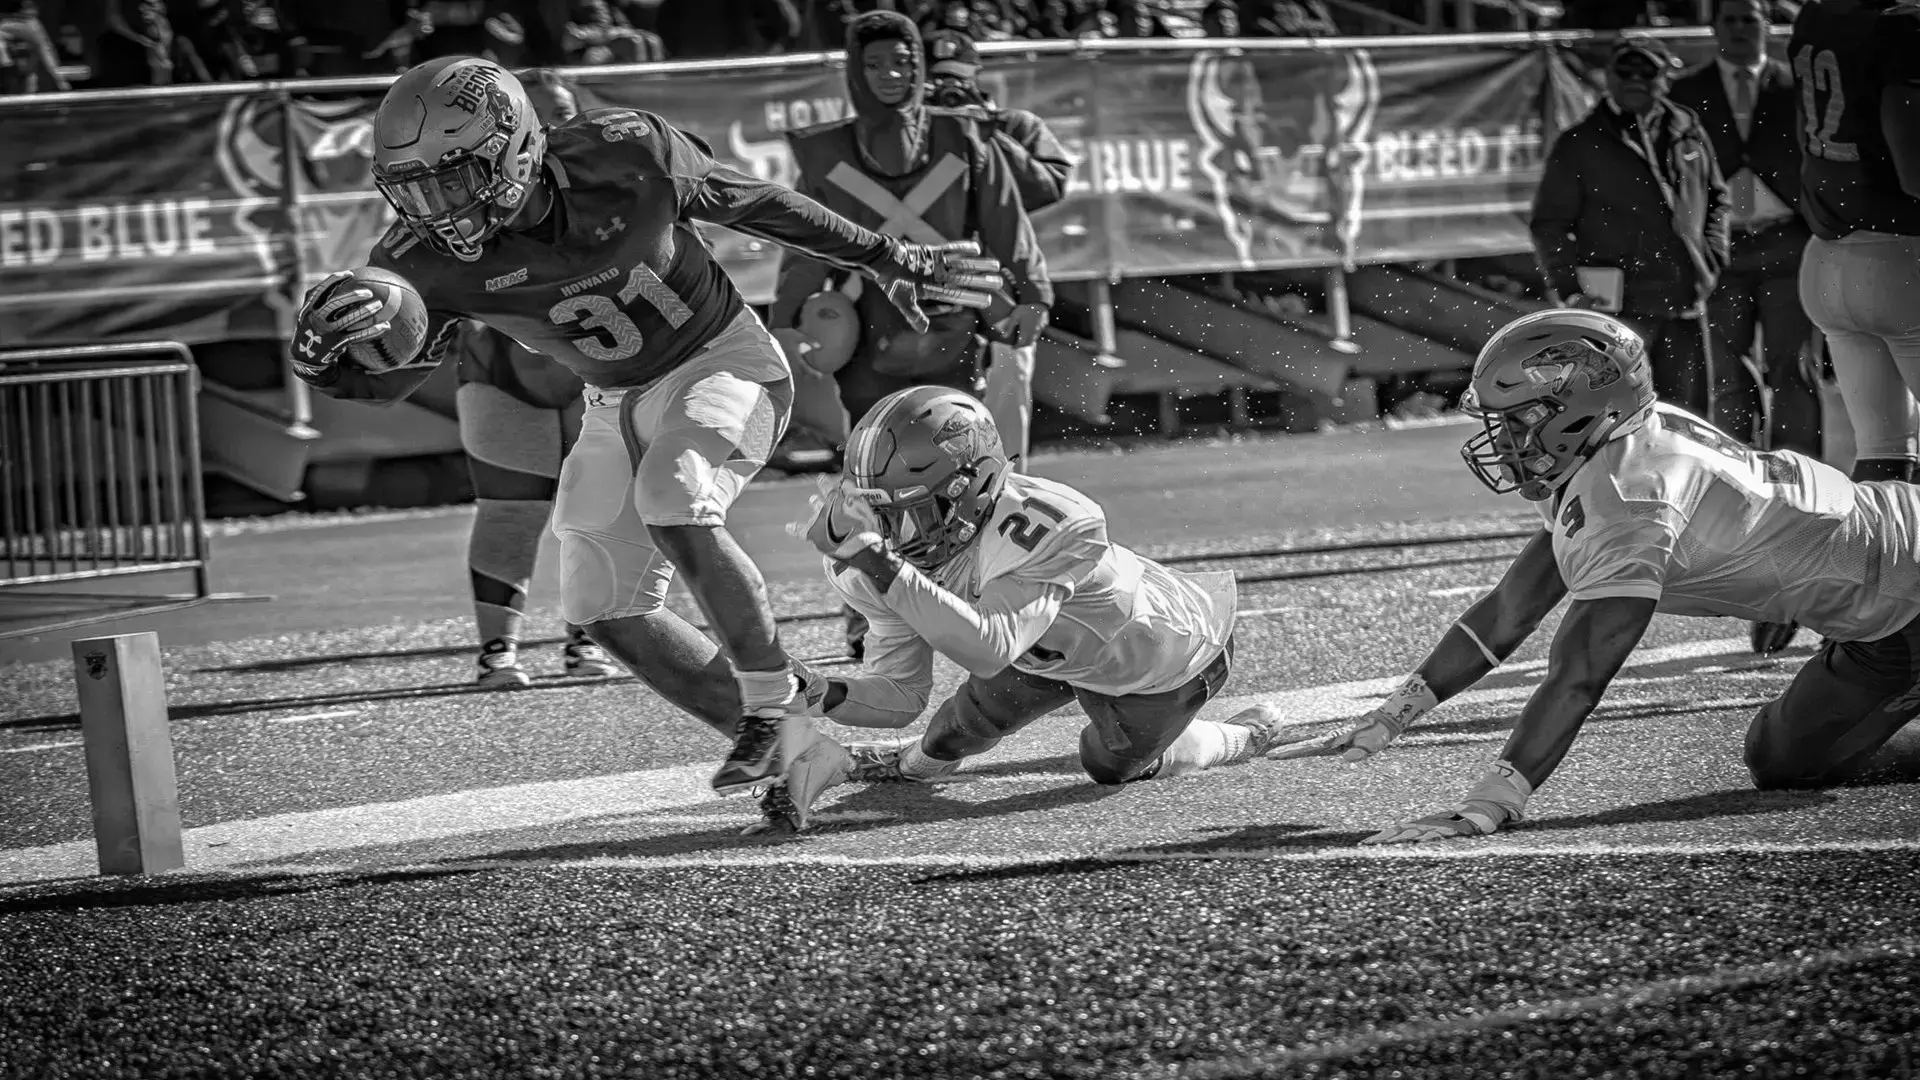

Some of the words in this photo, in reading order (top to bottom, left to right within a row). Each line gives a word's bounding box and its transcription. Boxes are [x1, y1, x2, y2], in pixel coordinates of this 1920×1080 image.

[444, 65, 502, 115] BISON
[1794, 44, 1860, 162] 12
[1089, 139, 1193, 194] BLUE
[1375, 126, 1489, 183] BLEED
[0, 207, 63, 267] ED
[79, 197, 216, 262] BLUE
[485, 267, 529, 292] MEAC
[560, 266, 620, 298] HOWARD
[548, 260, 696, 362] 31
[997, 496, 1069, 553] 21
[1560, 494, 1586, 540] 9
